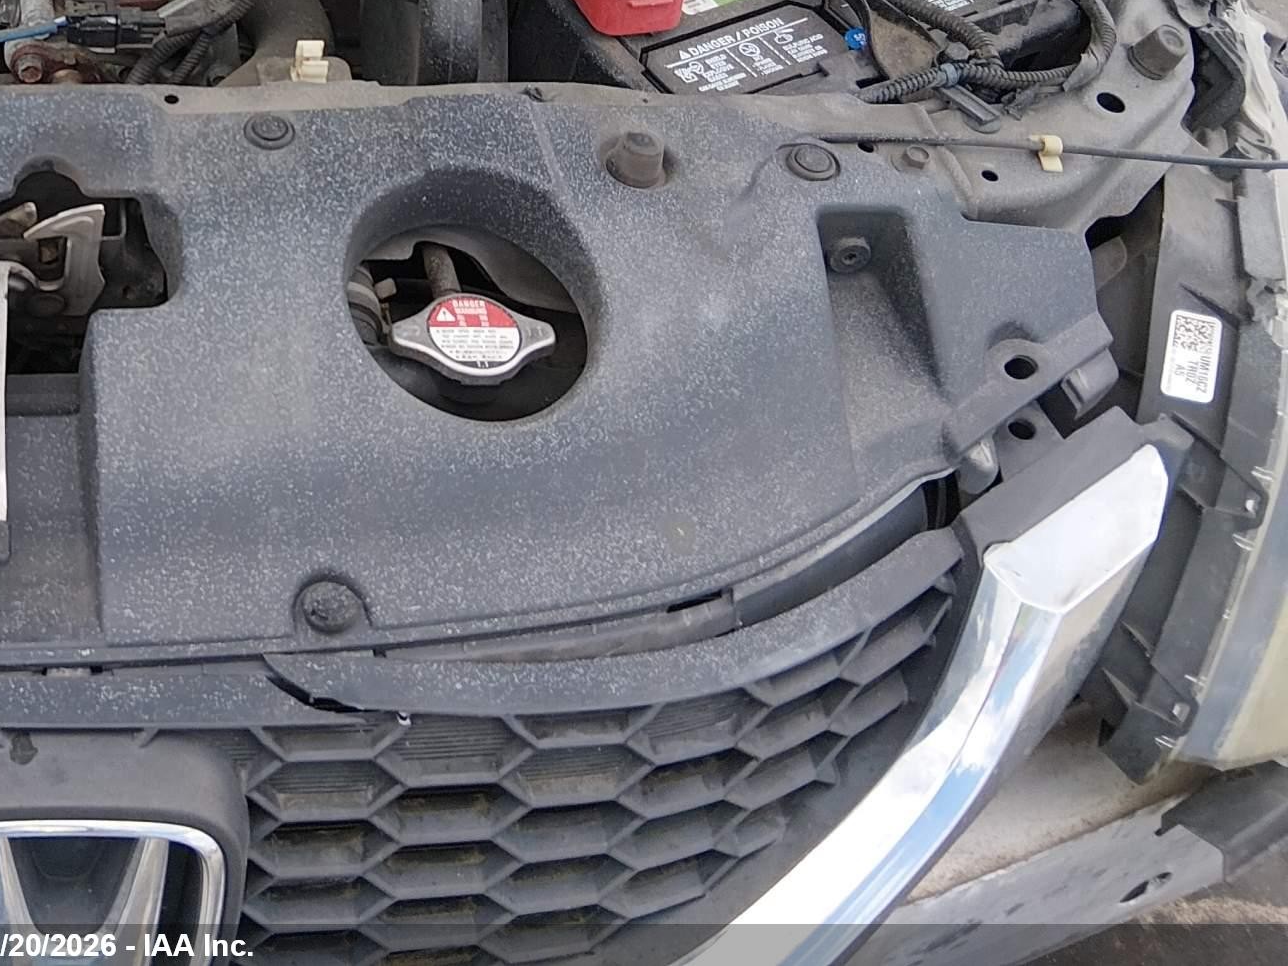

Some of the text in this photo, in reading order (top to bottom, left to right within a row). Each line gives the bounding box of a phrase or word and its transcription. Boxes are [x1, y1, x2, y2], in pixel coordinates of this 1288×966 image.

[688, 36, 736, 57] DANGER
[742, 18, 785, 37] POISON
[452, 299, 486, 308] DANGER
